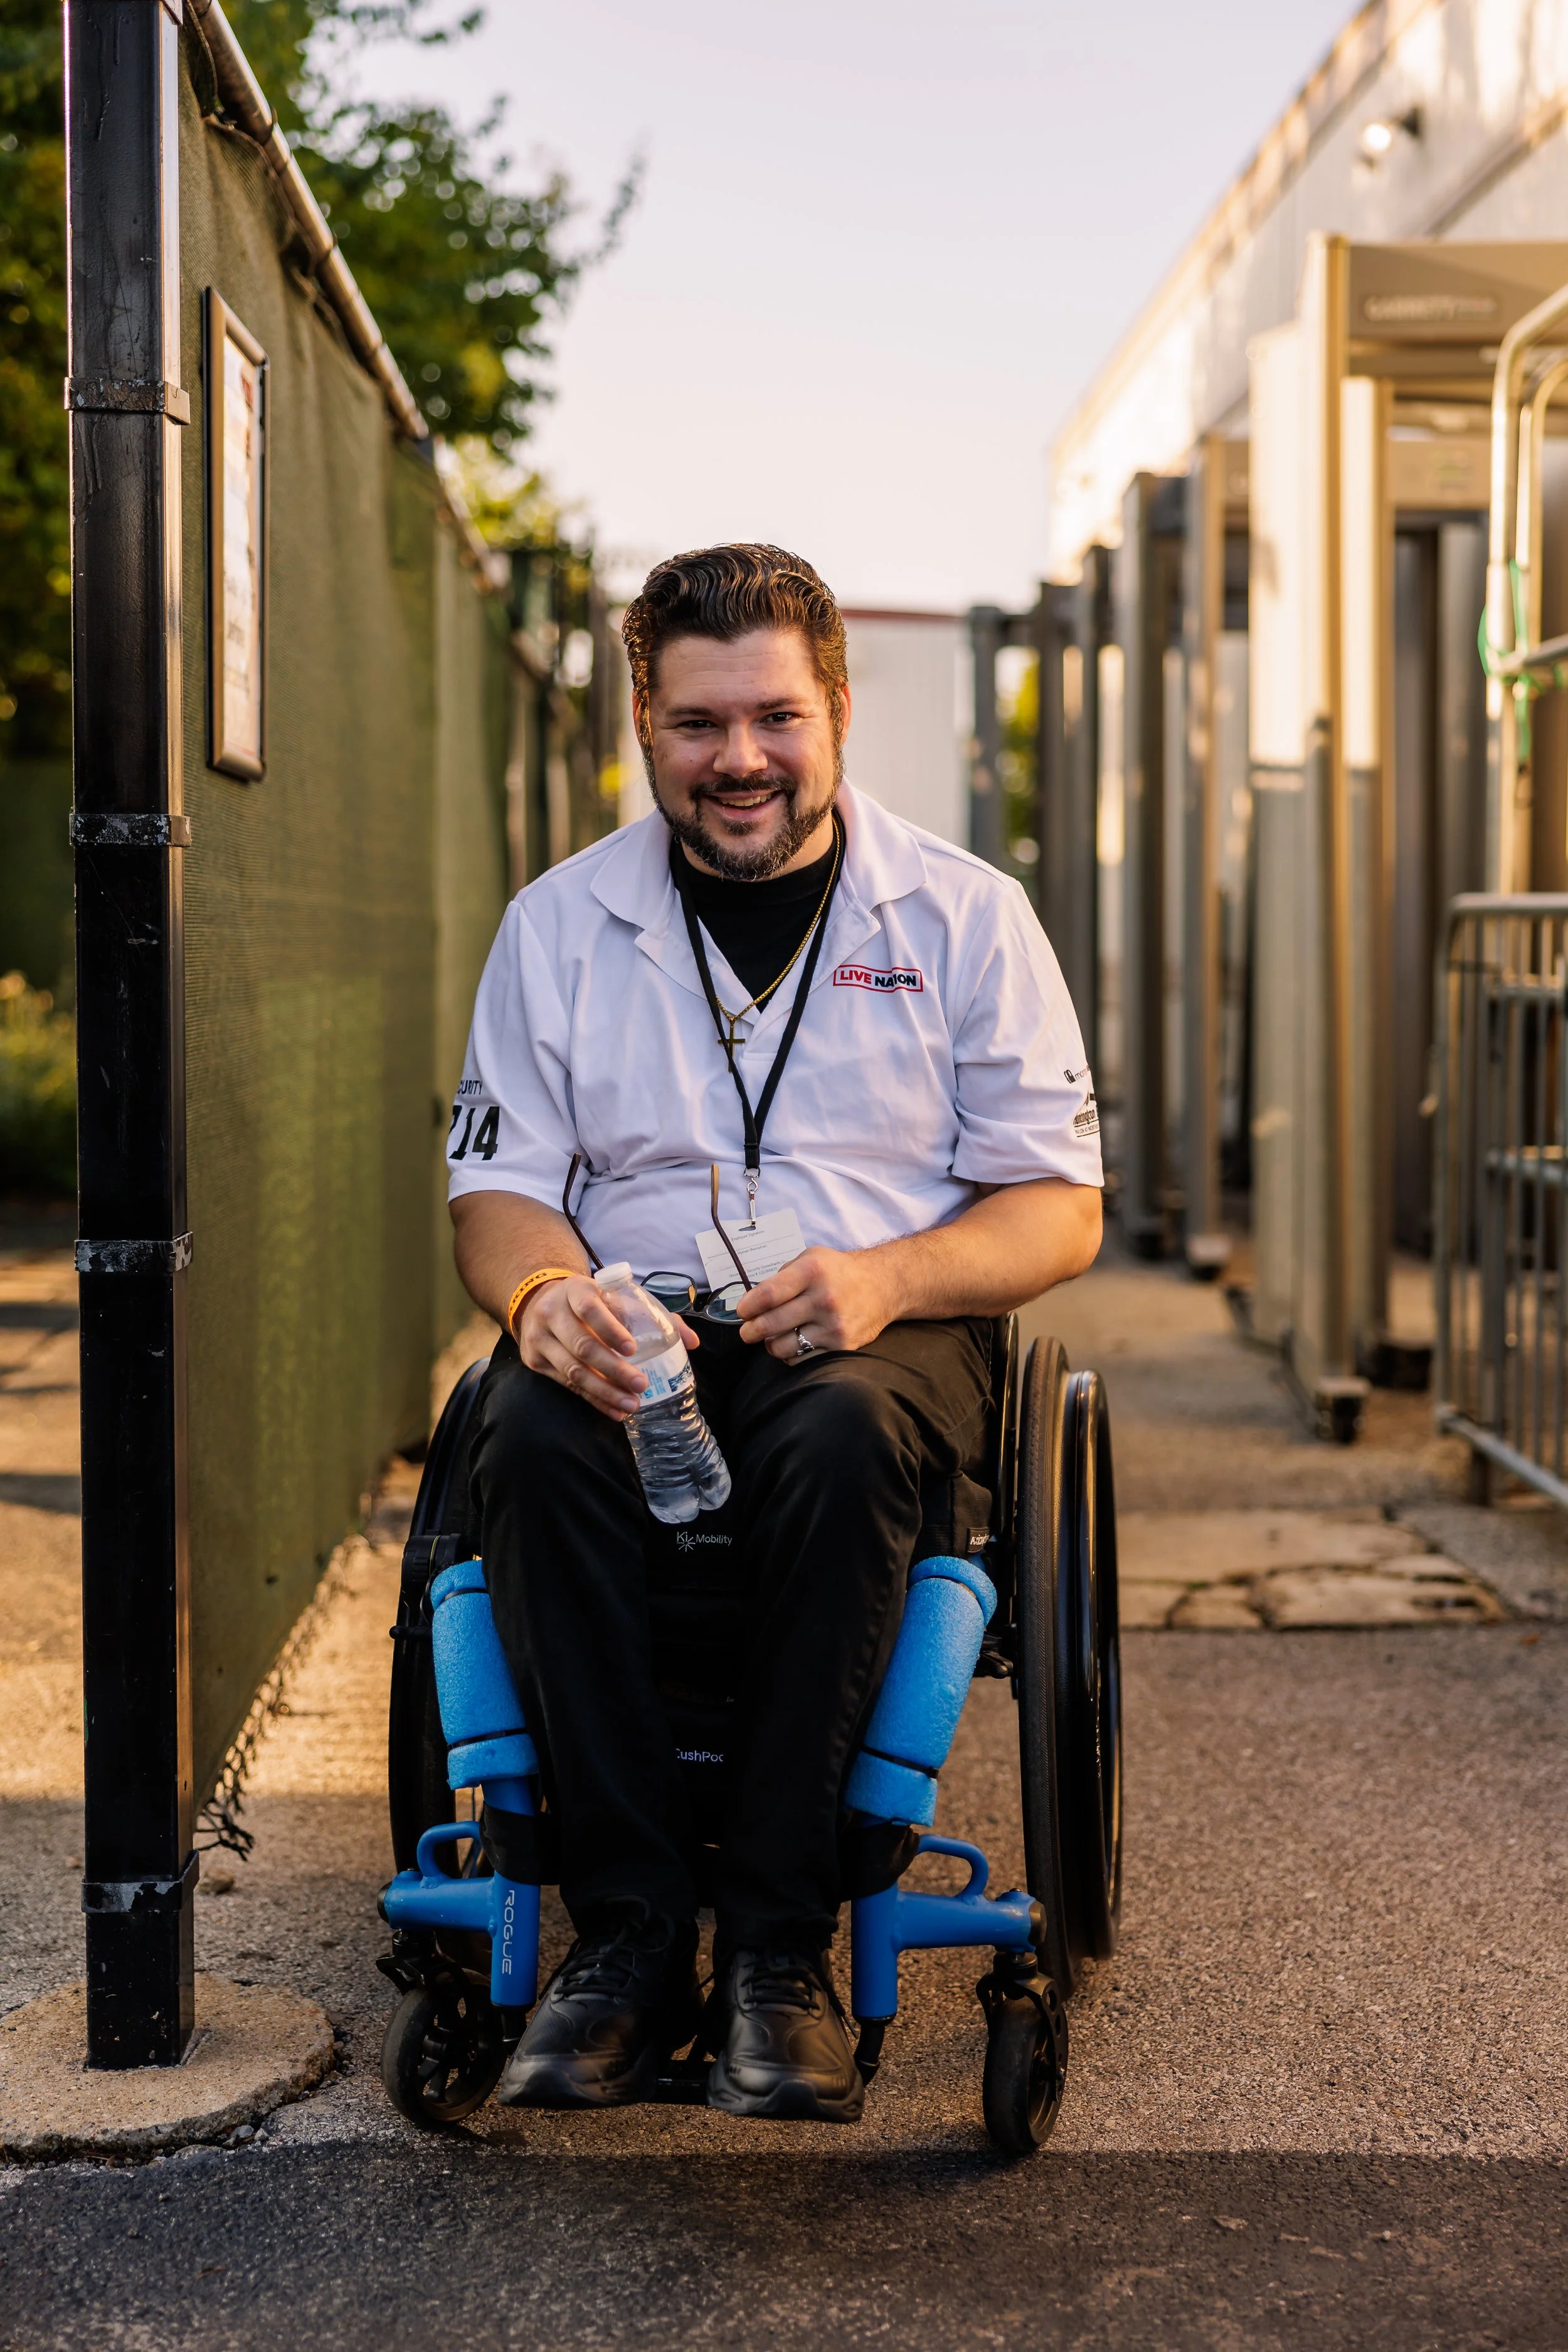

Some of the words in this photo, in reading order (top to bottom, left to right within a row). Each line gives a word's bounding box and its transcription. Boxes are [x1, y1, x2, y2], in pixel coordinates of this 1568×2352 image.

[840, 970, 872, 984] LIVE
[874, 973, 917, 988] NAION
[696, 1534, 733, 1547] Mobility
[502, 1890, 515, 1975] ROGUE
